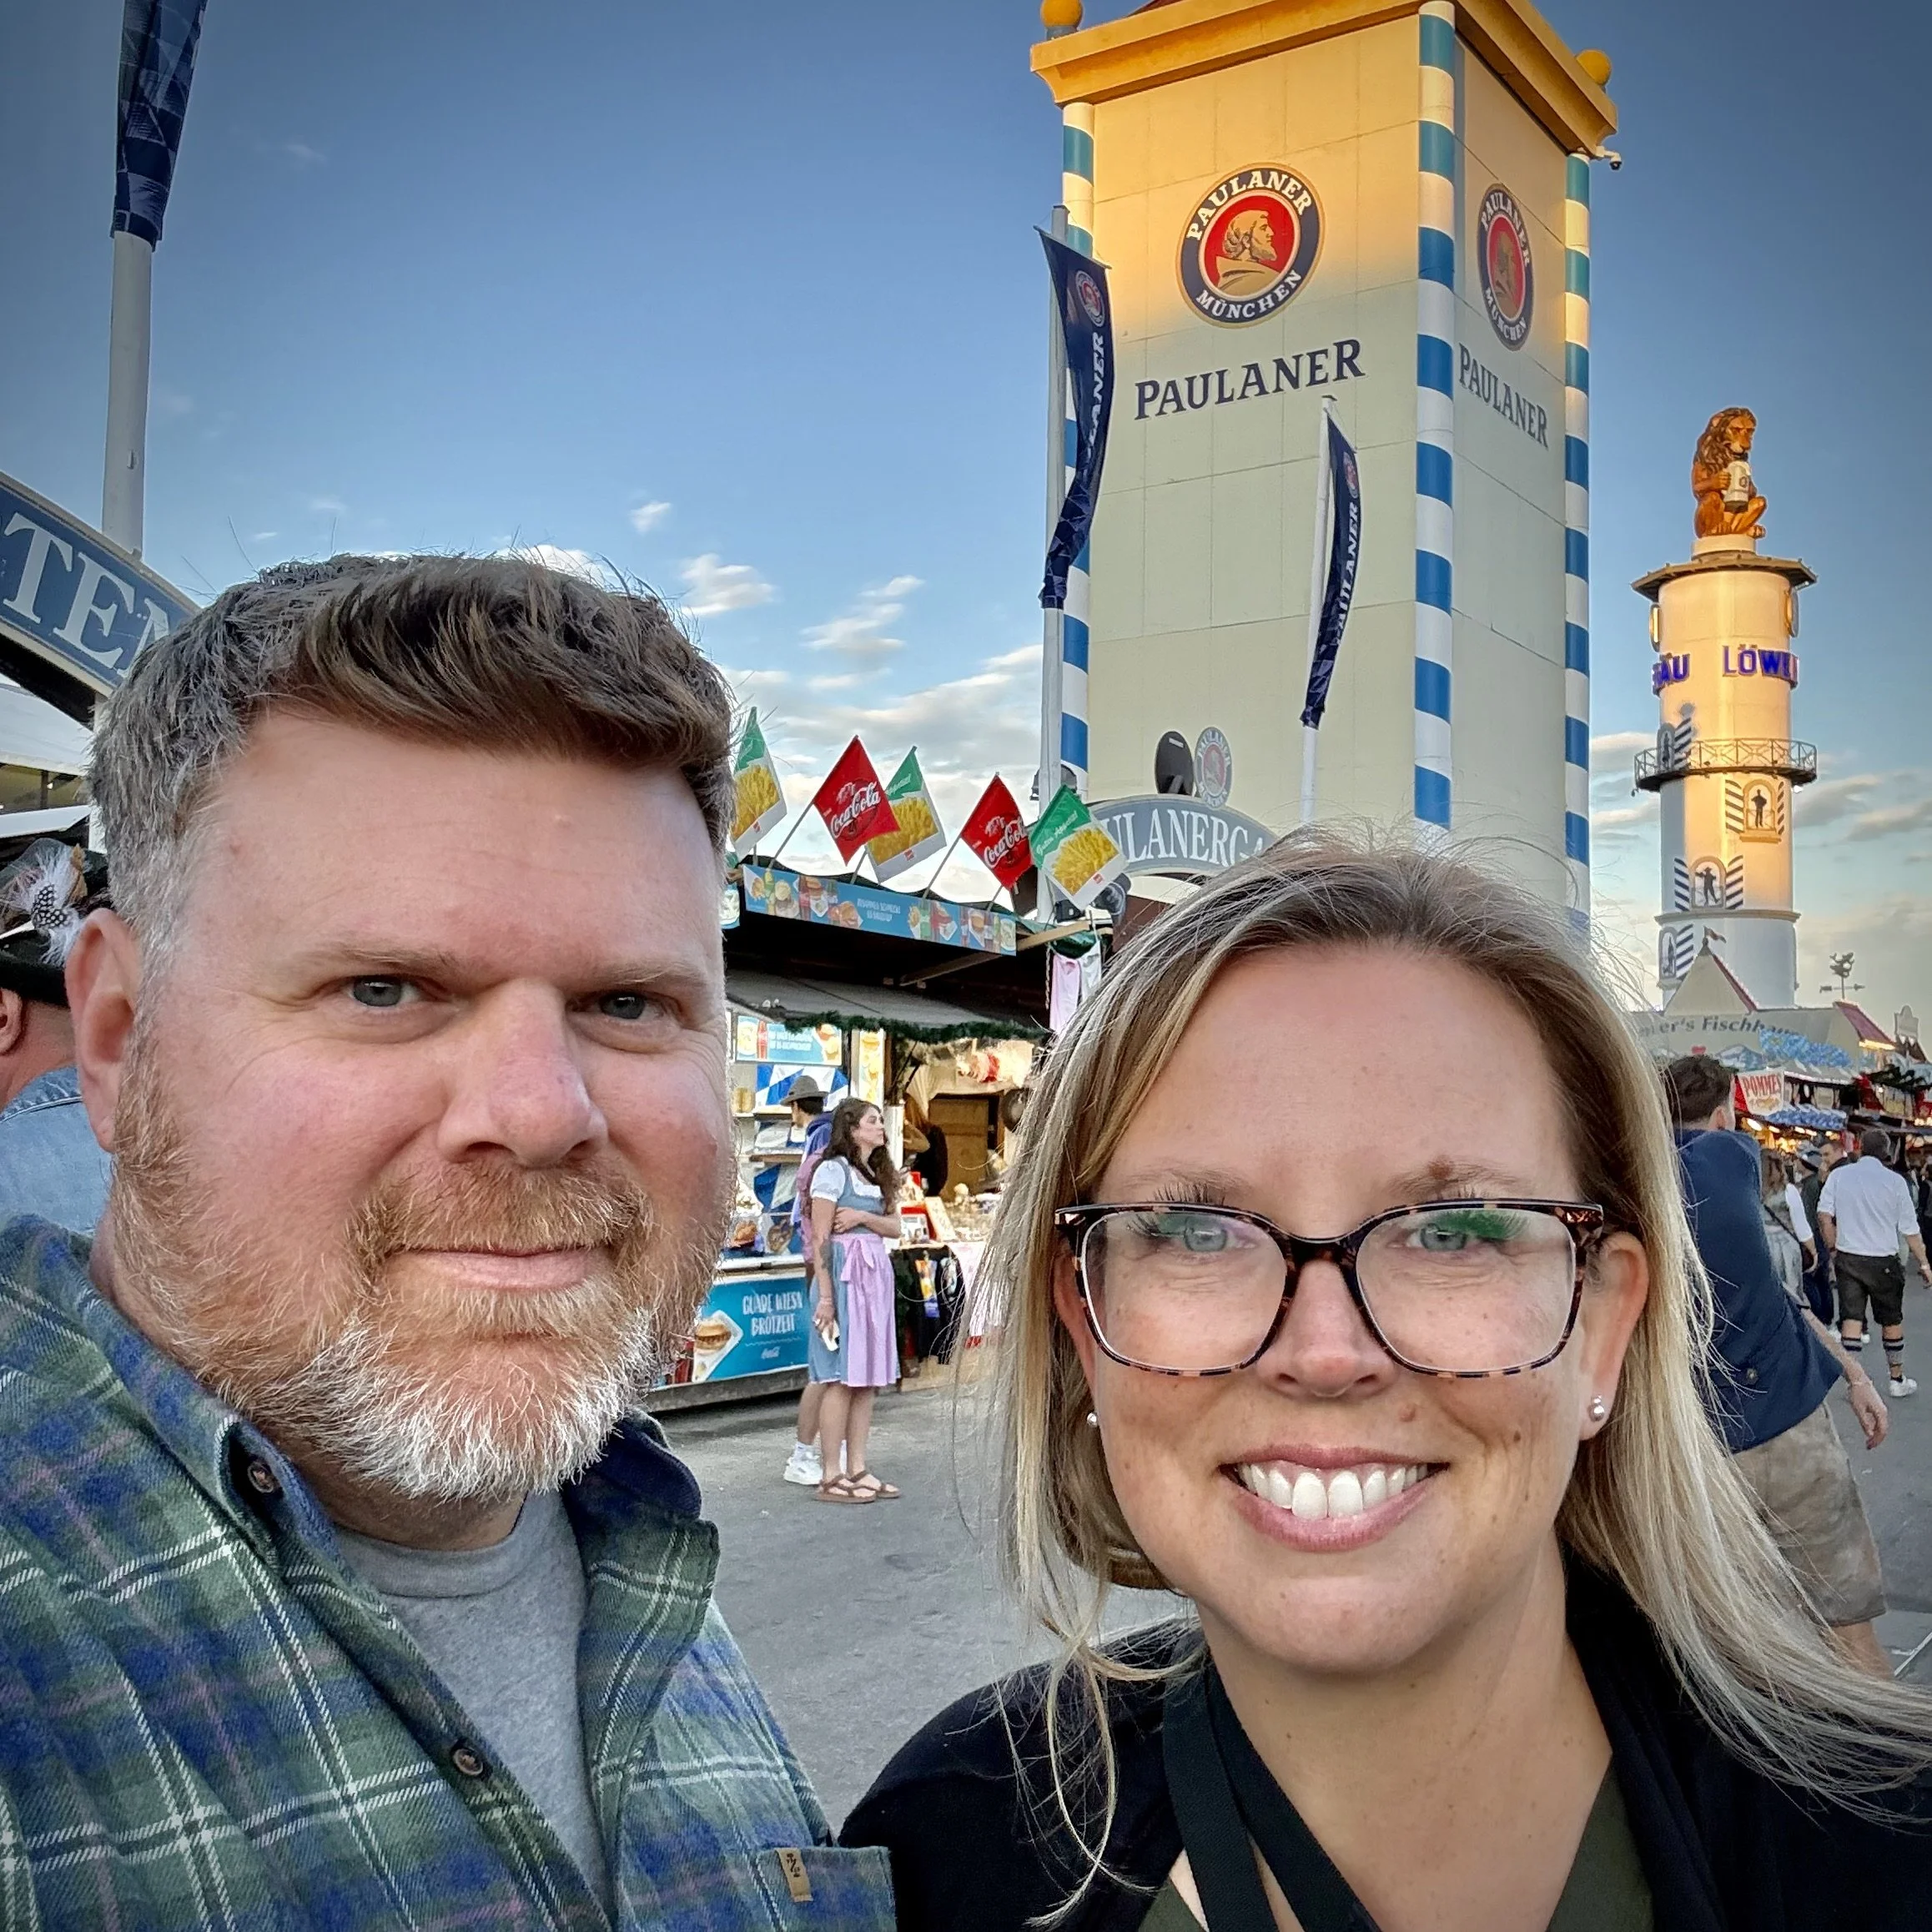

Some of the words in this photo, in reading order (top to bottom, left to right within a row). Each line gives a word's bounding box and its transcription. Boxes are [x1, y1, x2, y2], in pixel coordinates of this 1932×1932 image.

[1185, 169, 1313, 242] PAULANER
[1482, 191, 1530, 267] PAULANER
[1195, 269, 1303, 319] MÜNCHEN
[1134, 339, 1366, 420] PAULANER
[1458, 342, 1549, 450] PAULANER
[984, 818, 1029, 868] Coca-Col
